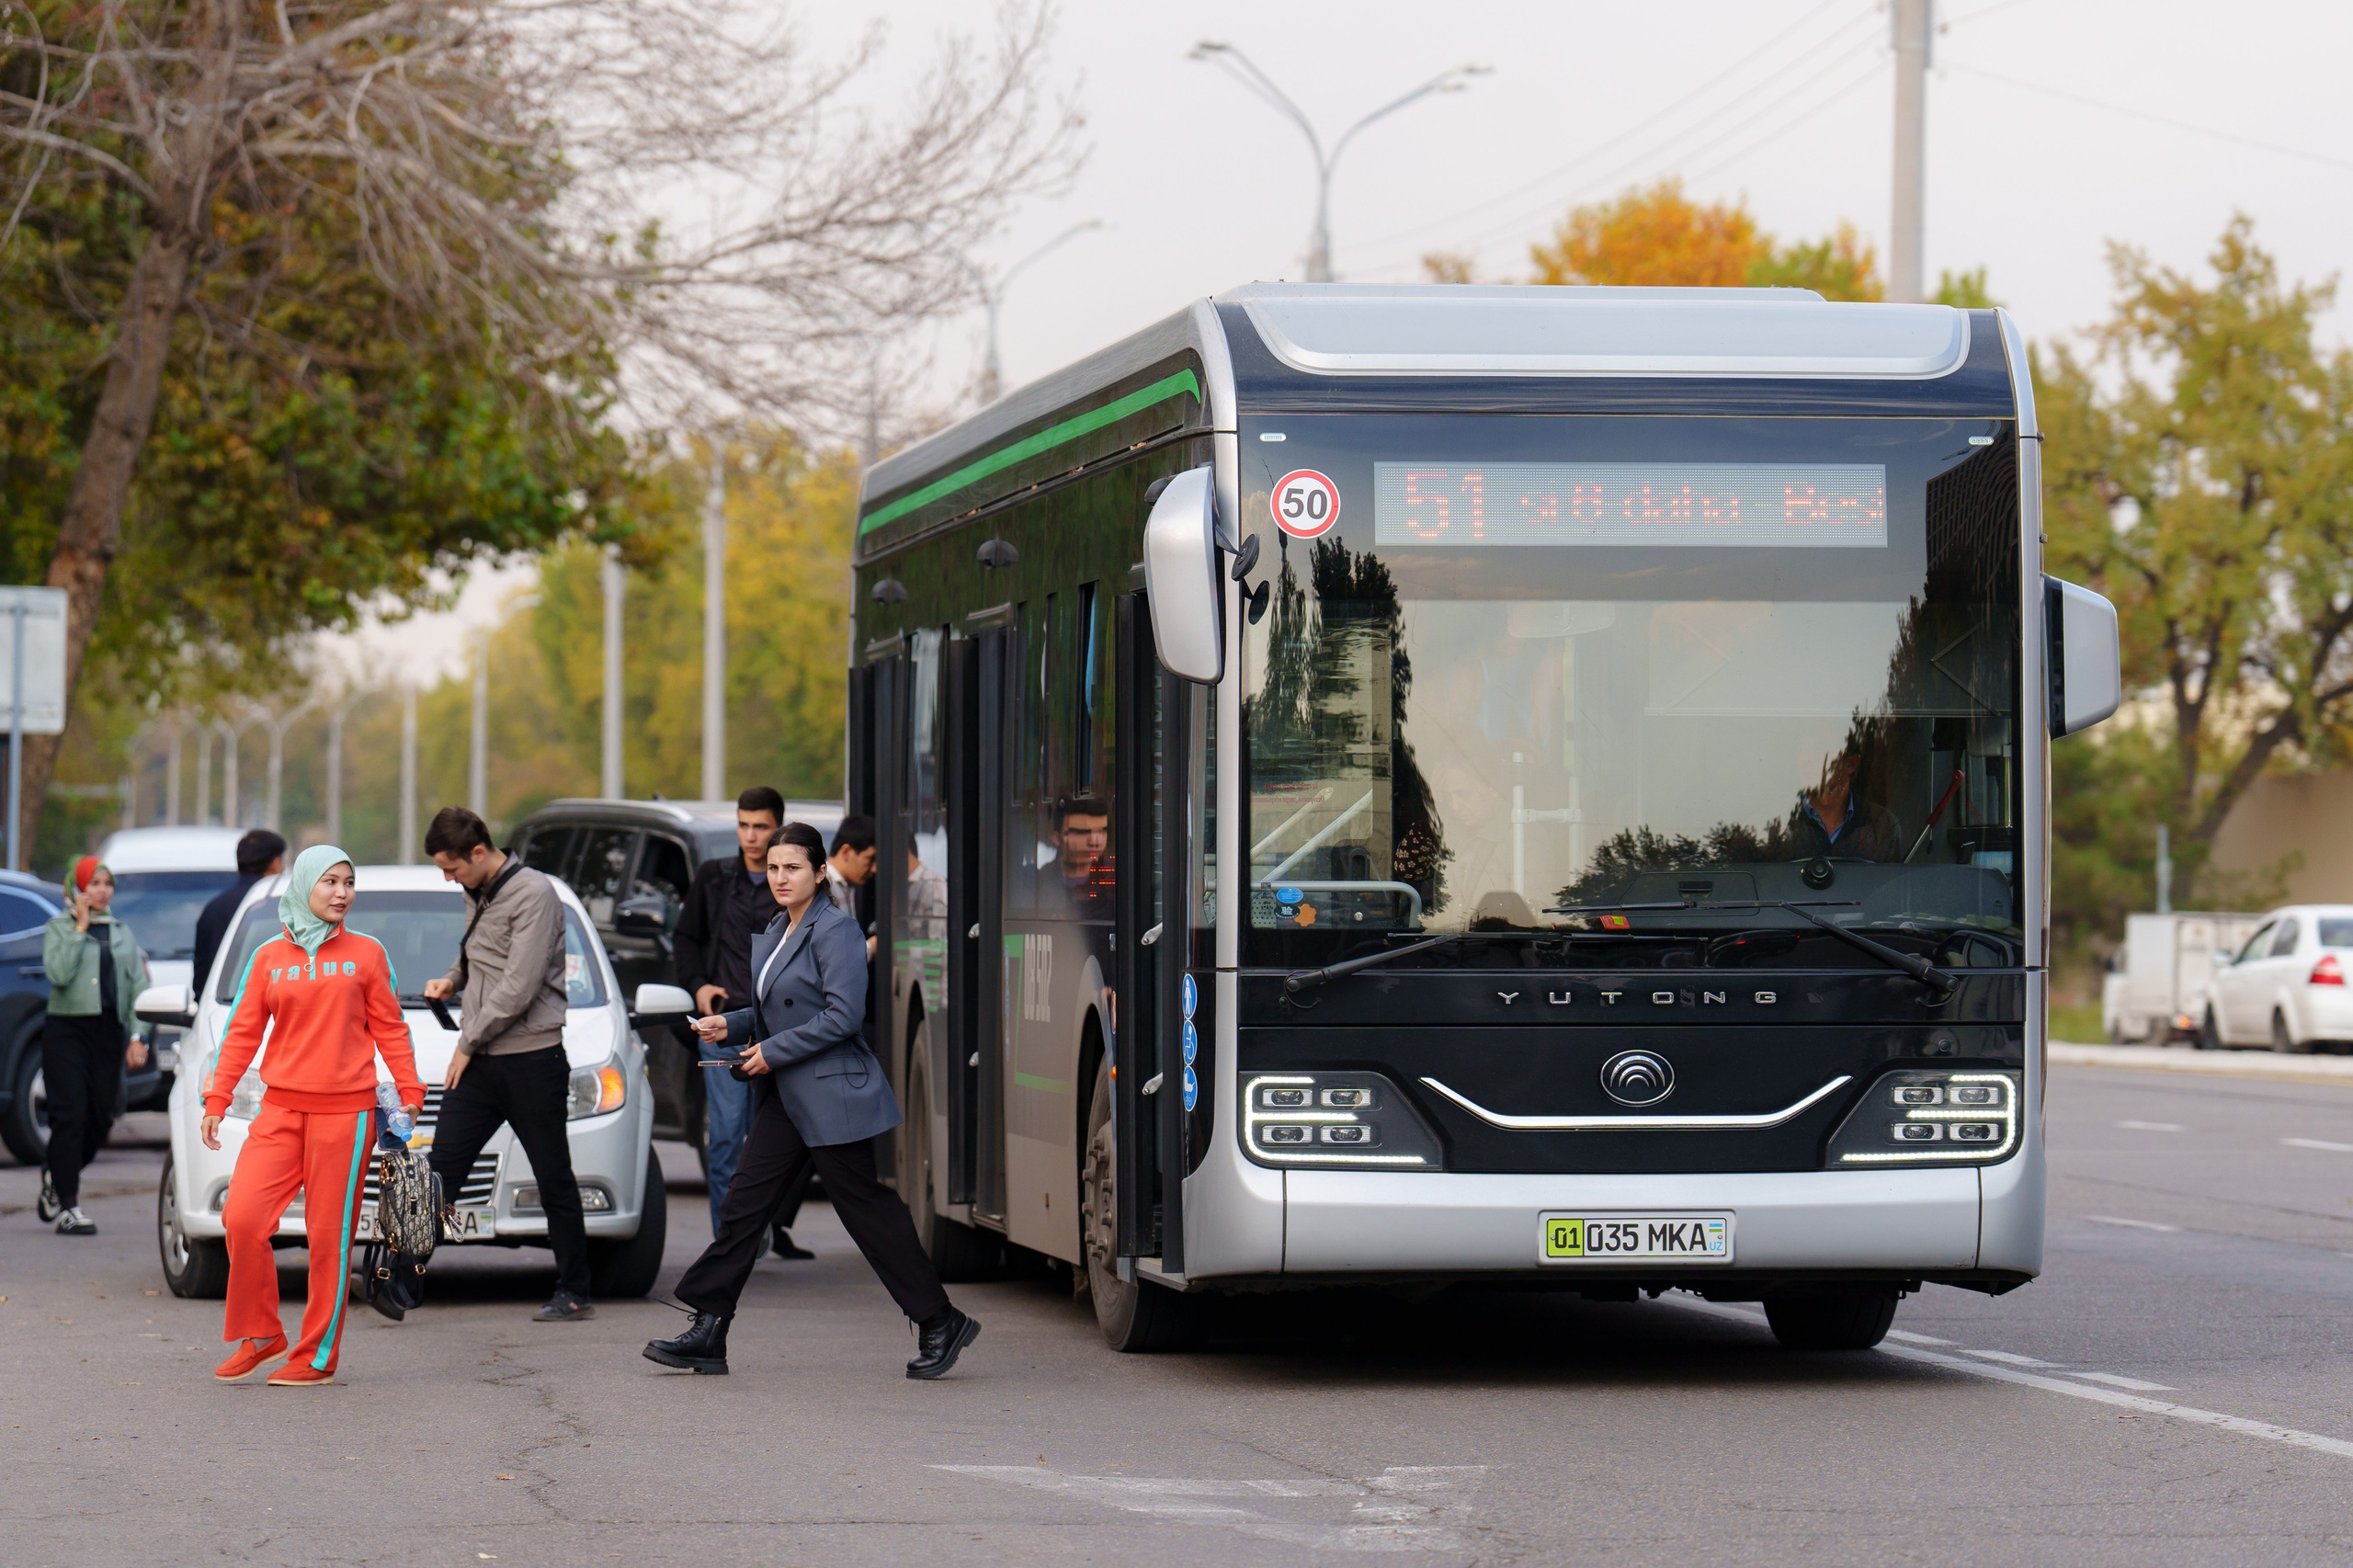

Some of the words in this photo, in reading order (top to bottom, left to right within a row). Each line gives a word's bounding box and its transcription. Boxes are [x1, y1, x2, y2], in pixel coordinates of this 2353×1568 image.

[1283, 488, 1327, 519] 50
[1406, 468, 1483, 537] 51
[1497, 992, 1777, 1005] YUTONG
[1554, 1227, 1580, 1248] 01
[1586, 1223, 1639, 1252] 035
[1648, 1223, 1707, 1251] MKA
[1709, 1241, 1723, 1251] UZ
